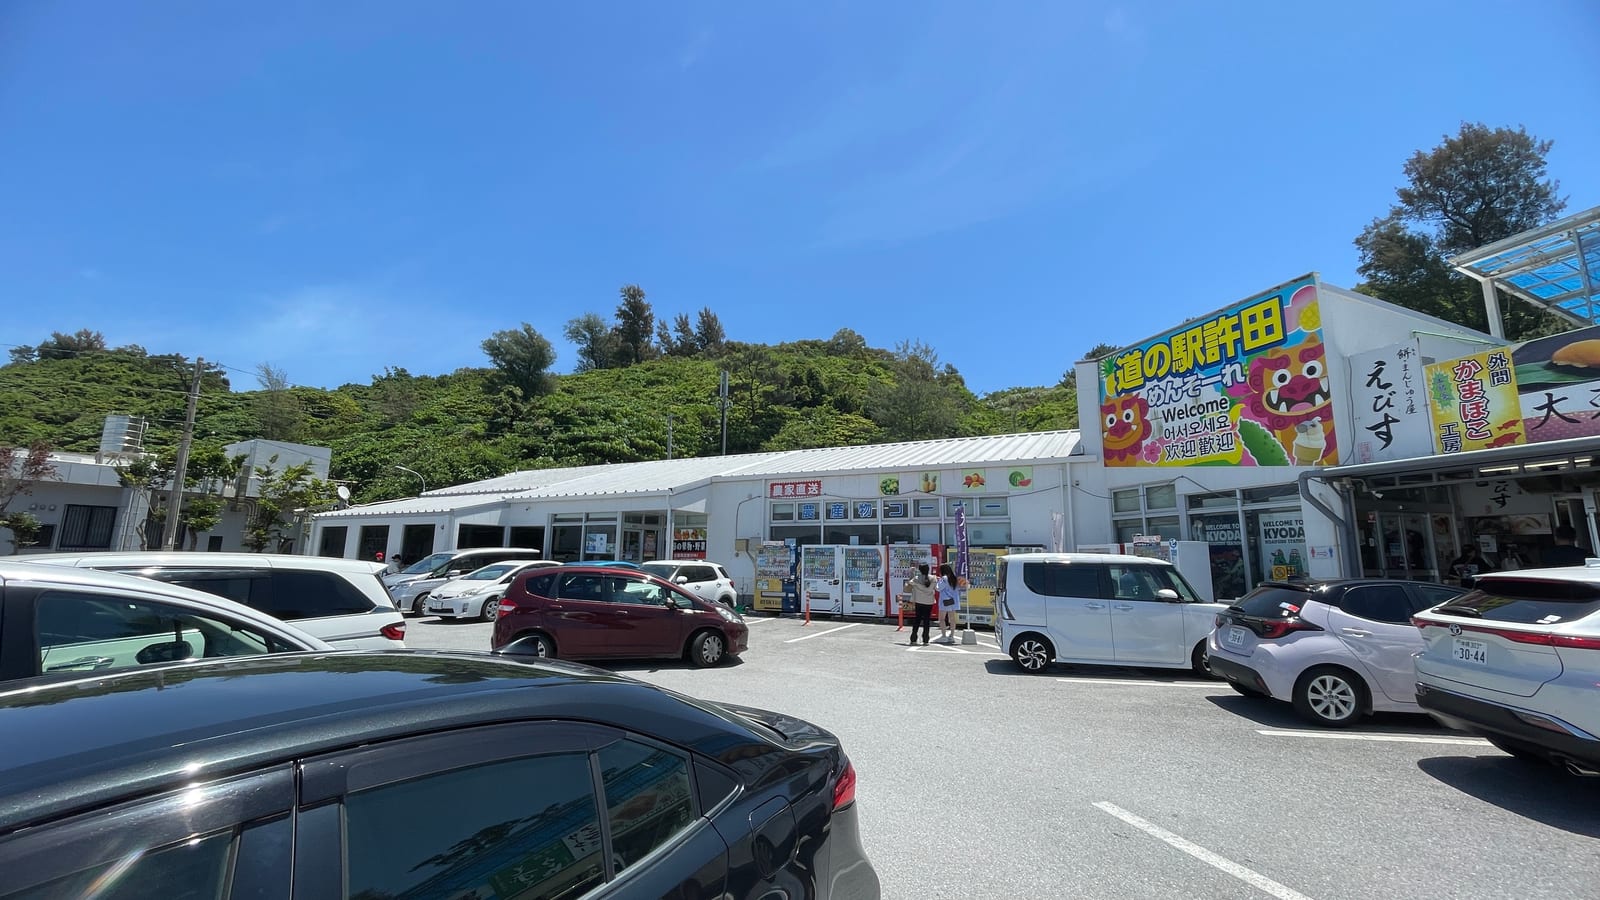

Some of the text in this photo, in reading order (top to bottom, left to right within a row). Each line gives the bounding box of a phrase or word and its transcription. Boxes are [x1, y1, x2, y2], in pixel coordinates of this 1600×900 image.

[1114, 295, 1286, 392] 道の駅許田
[1488, 352, 1511, 387] 外間
[1147, 363, 1246, 408] めんそーれ
[1162, 396, 1229, 423] Welcome
[1365, 360, 1401, 451] えびす
[1164, 415, 1231, 441] 어서오세요
[1440, 422, 1462, 454] 工房
[1165, 432, 1234, 461] 欢迎 歡迎
[1262, 520, 1293, 528] WELCOME
[1264, 527, 1305, 539] KYODA
